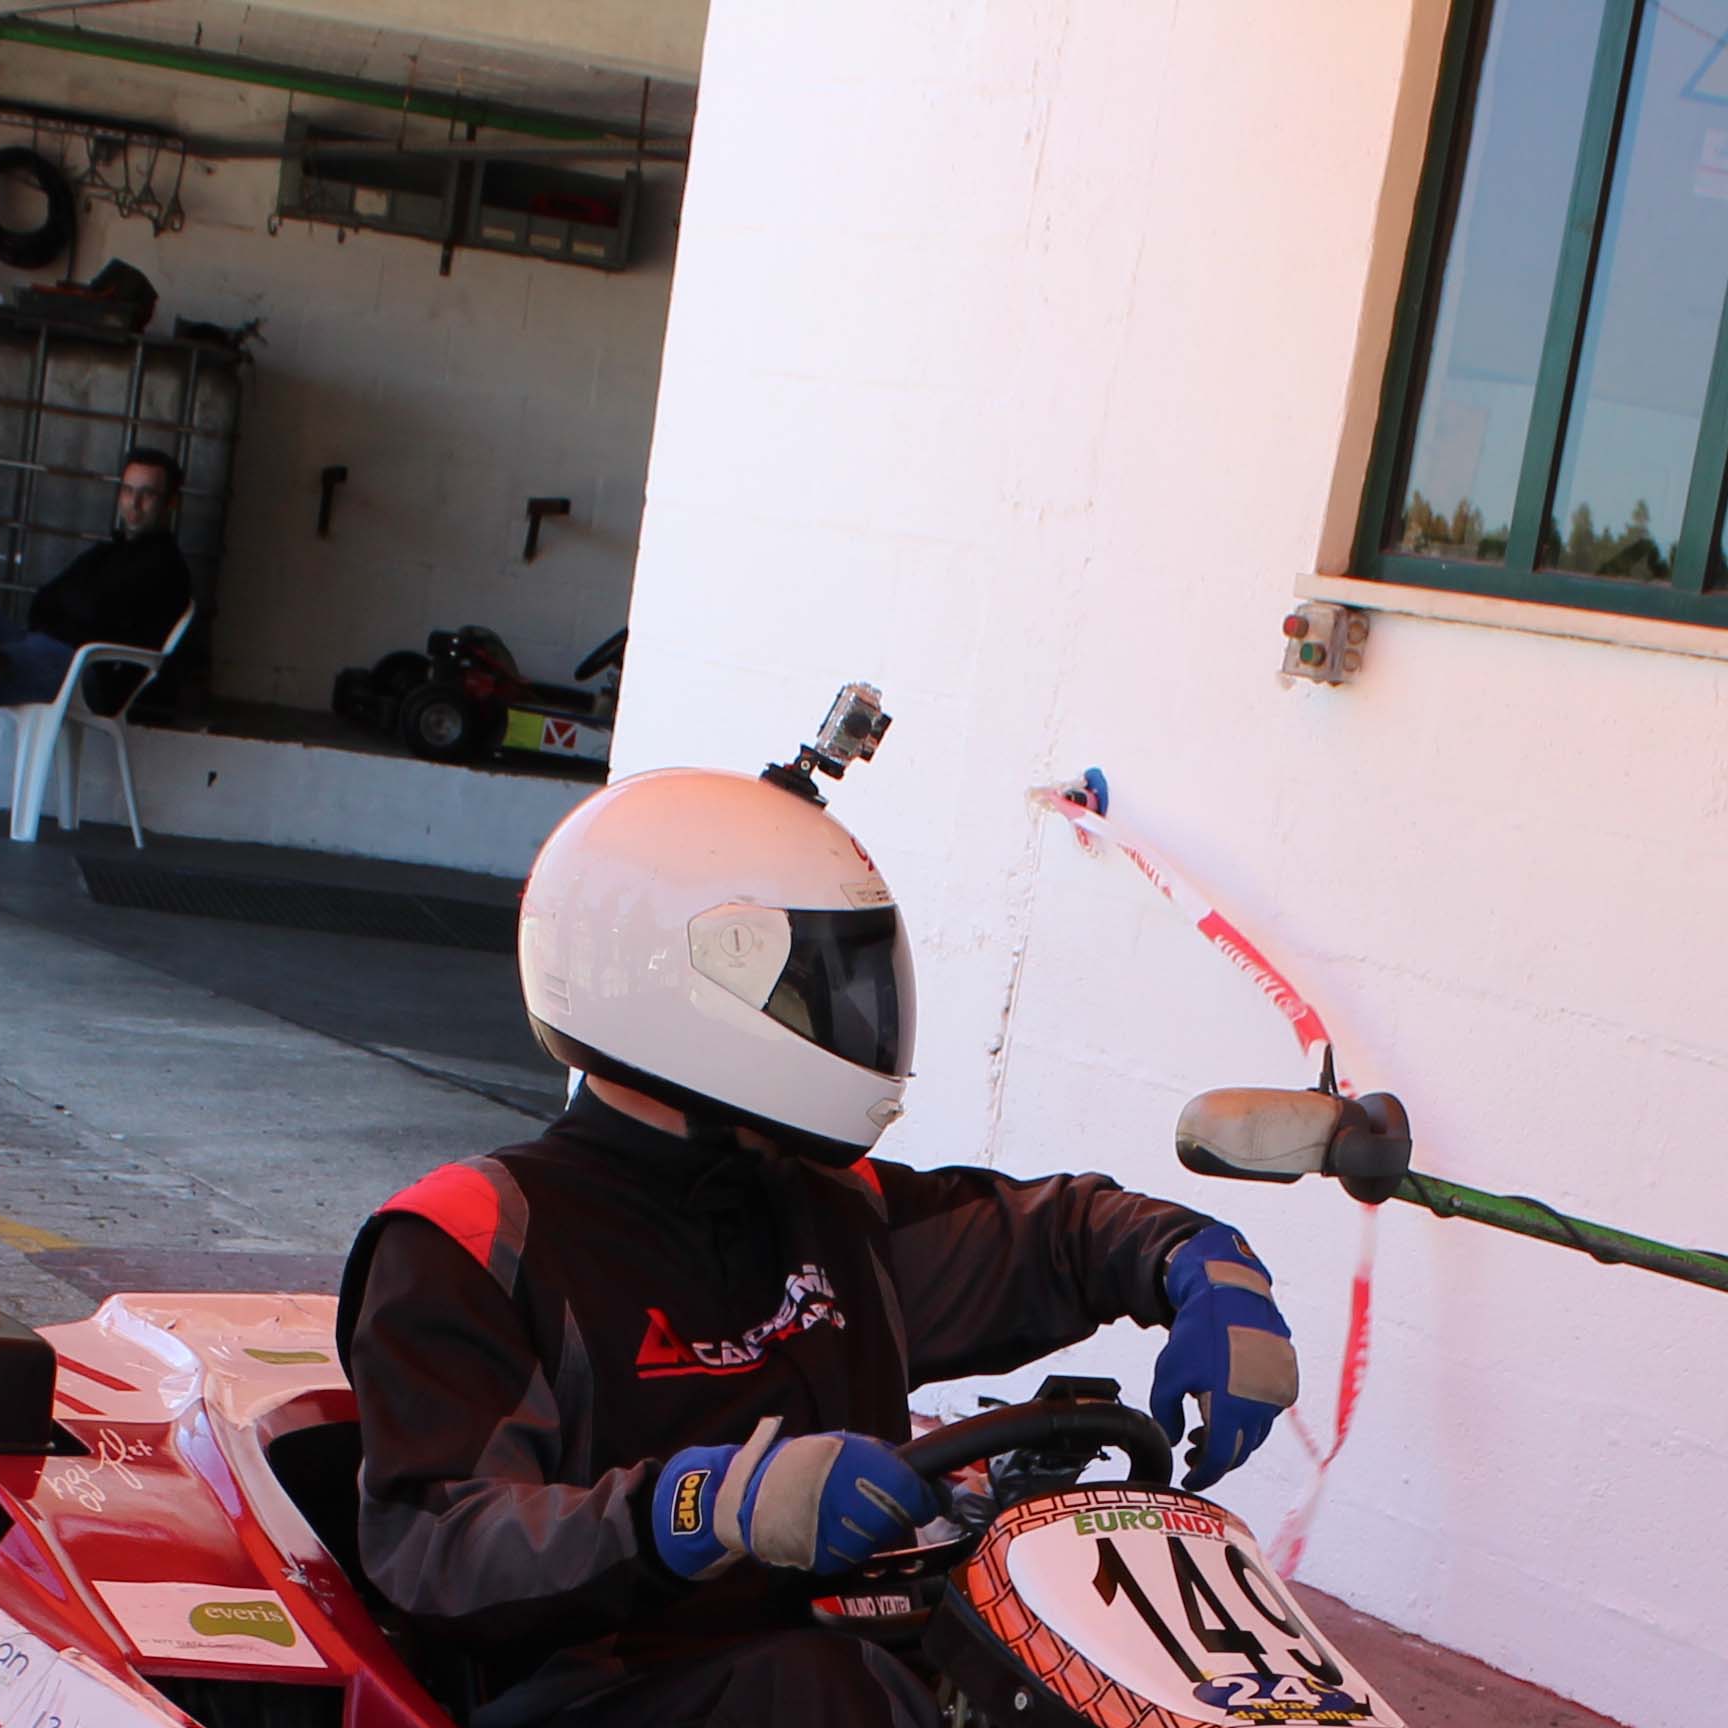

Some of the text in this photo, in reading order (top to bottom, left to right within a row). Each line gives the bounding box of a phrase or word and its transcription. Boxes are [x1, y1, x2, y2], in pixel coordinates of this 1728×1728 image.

[679, 1475, 701, 1532] OMP
[1073, 1509, 1226, 1538] EUROINDY
[204, 1605, 285, 1624] everis
[1092, 1536, 1344, 1686] 149
[1212, 1675, 1324, 1707] 24
[1266, 1710, 1368, 1722] Batalha
